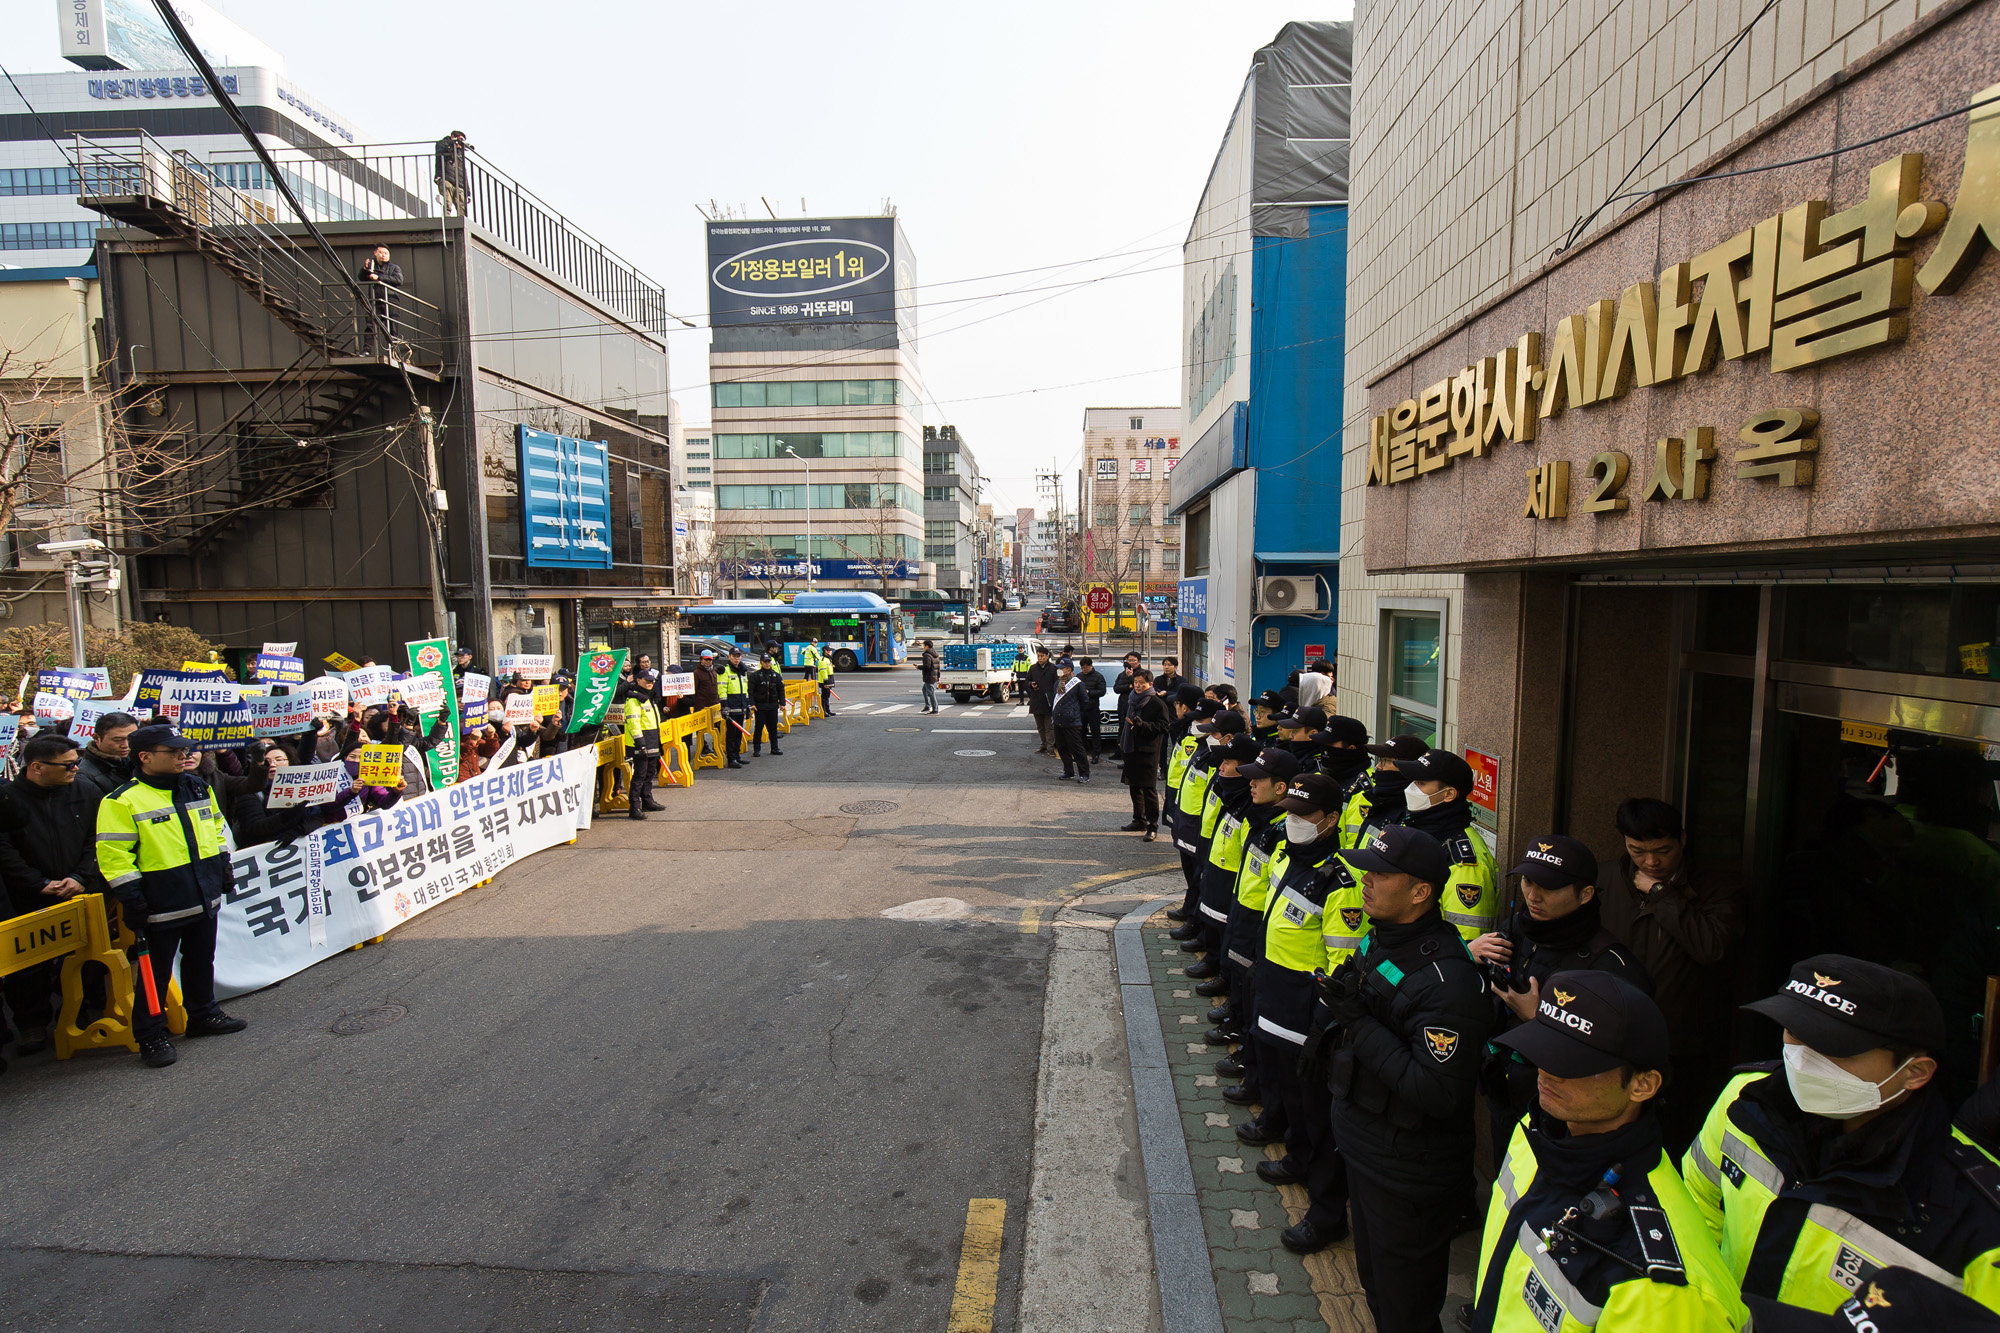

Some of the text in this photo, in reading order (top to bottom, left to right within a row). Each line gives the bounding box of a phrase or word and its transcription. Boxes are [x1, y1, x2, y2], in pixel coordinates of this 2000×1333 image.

[87, 74, 240, 100] 대한지방행정공회
[730, 250, 865, 282] 가정용보일러 1위
[750, 300, 854, 318] SINCE 1969 귀뚜라미
[1090, 602, 1109, 610] STOP
[258, 658, 280, 668] 사이비
[256, 669, 278, 680] 강력히
[140, 688, 160, 700] 강력
[170, 688, 232, 702] 시사저널은
[352, 686, 372, 700] 기자
[36, 708, 52, 718] 기자
[250, 697, 311, 716] 3류 소설 쓰는
[184, 710, 218, 726] 사이비
[283, 710, 314, 726] 각성하라!
[182, 727, 214, 742] 강력히
[362, 752, 382, 763] 언론
[276, 766, 340, 784] 가짜언론 시사저널
[360, 765, 380, 778] 즉각
[272, 781, 337, 799] 구독 중단하자!
[448, 758, 566, 821] 안보단체로서
[1526, 850, 1563, 866] POLICE
[244, 886, 332, 938] 국가
[348, 824, 476, 904] 안보정책을
[478, 808, 511, 844] 적극
[308, 834, 324, 916] 대한민국재향군인회
[412, 842, 516, 907] 대한민국재향군인회
[1284, 912, 1302, 926] POLICE
[14, 920, 72, 954] LINE
[1785, 980, 1858, 1016] POLICE
[1538, 1000, 1594, 1036] POLICE
[1530, 1274, 1558, 1322] 경찰
[1524, 1291, 1555, 1333] POLICE
